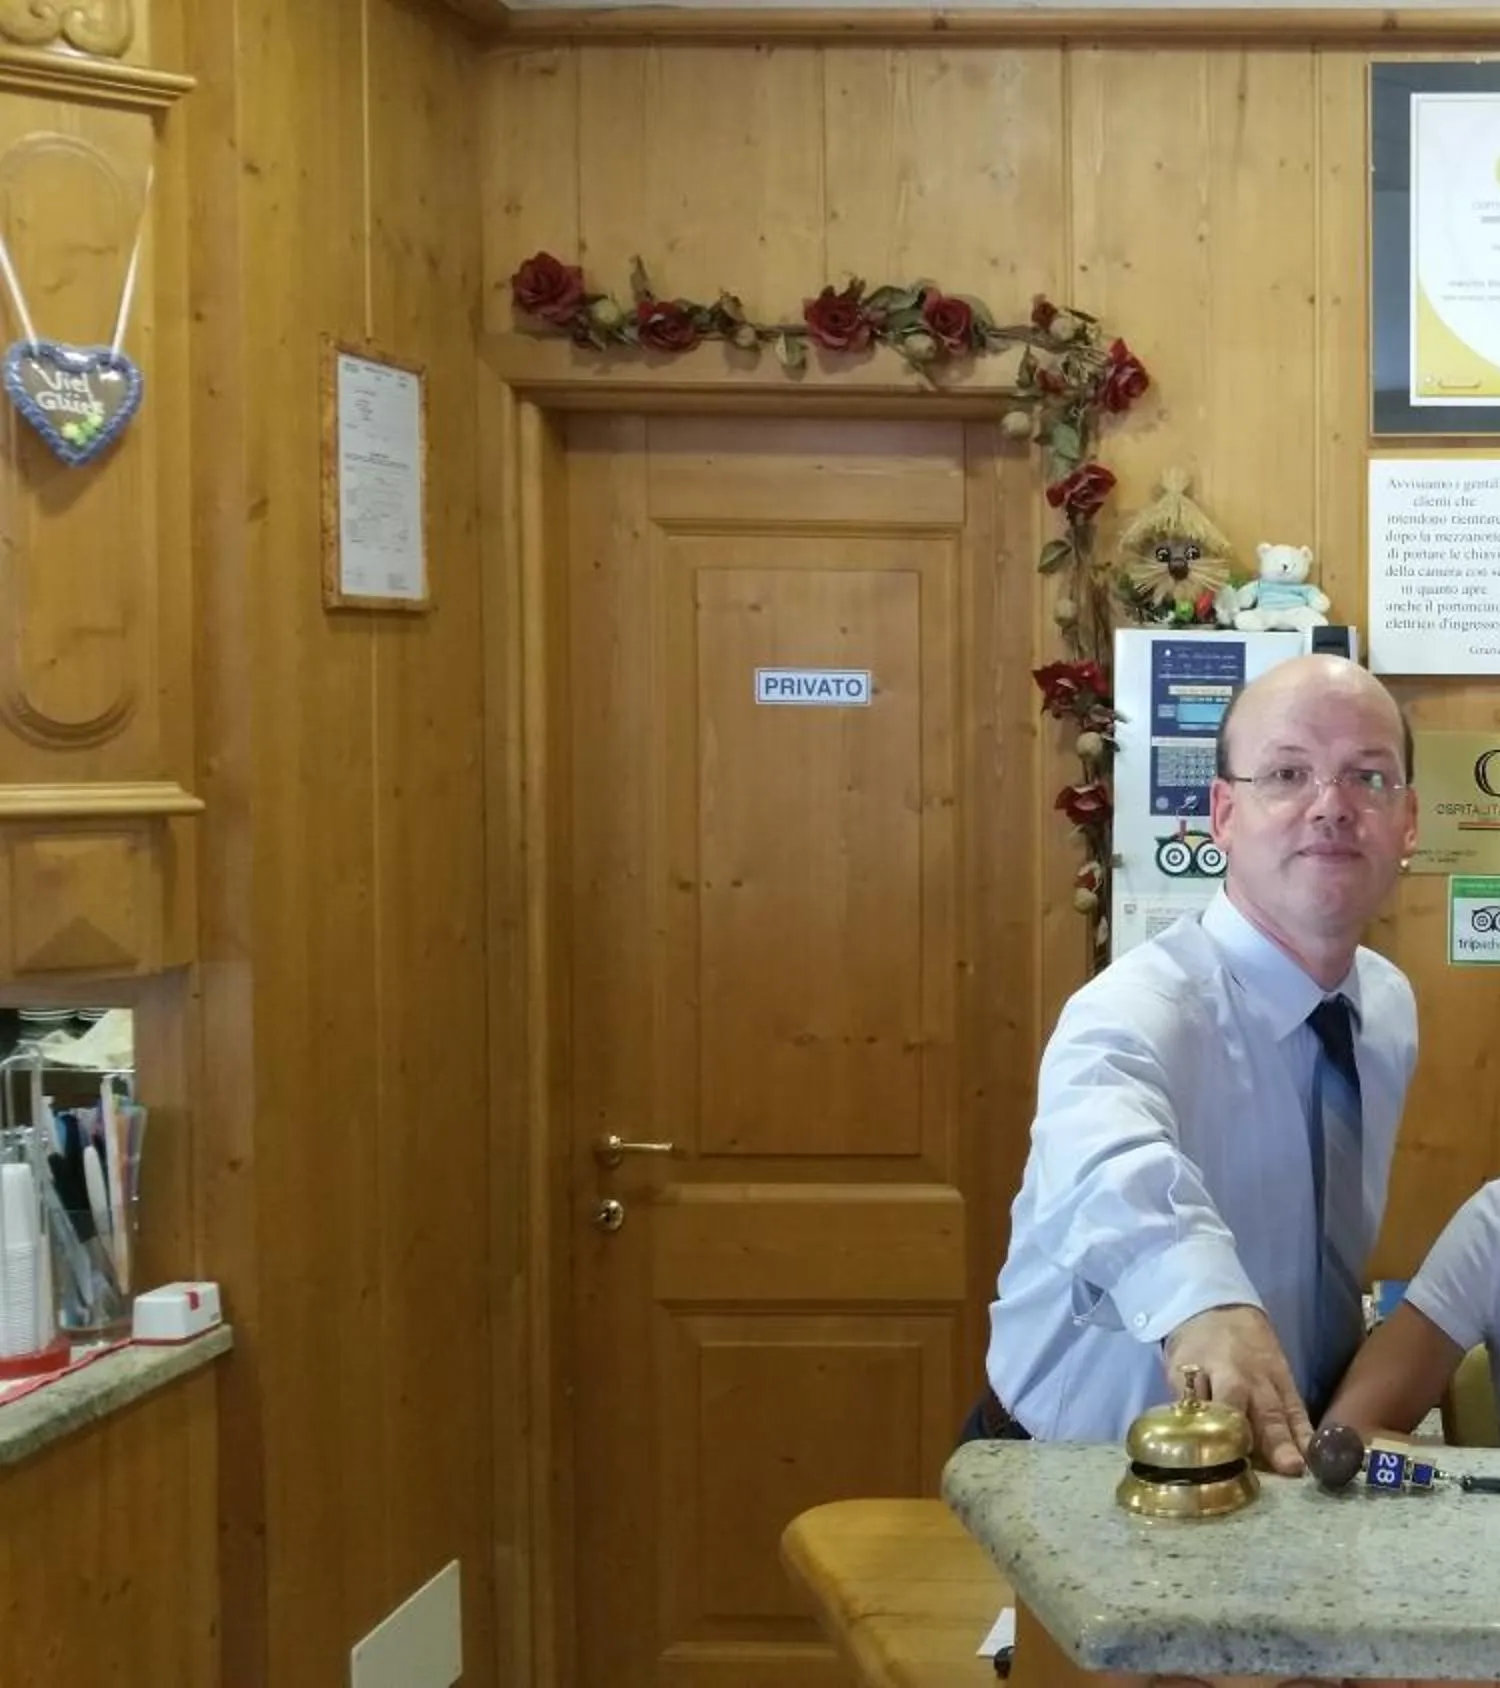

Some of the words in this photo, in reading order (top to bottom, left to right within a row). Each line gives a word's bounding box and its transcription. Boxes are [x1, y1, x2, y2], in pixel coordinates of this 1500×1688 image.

[29, 359, 90, 393] Viel
[1388, 478, 1452, 490] Avvisiamo
[1413, 495, 1450, 507] clienti
[1455, 495, 1476, 507] che
[1386, 513, 1447, 525] intendono
[1385, 530, 1417, 544] dopo
[1420, 530, 1430, 542] la
[1387, 548, 1399, 560] di
[1403, 550, 1447, 563] portare
[1449, 548, 1460, 560] le
[1463, 548, 1500, 560] chiavi
[1385, 566, 1415, 577] della
[1418, 567, 1462, 577] camera
[1416, 585, 1458, 597] quanto
[1461, 585, 1488, 597] apre
[1385, 601, 1422, 613] anche
[1425, 600, 1433, 613] il
[1385, 618, 1435, 629] elettrico
[764, 677, 863, 697] PRIVATO
[1376, 1453, 1400, 1484] 28
